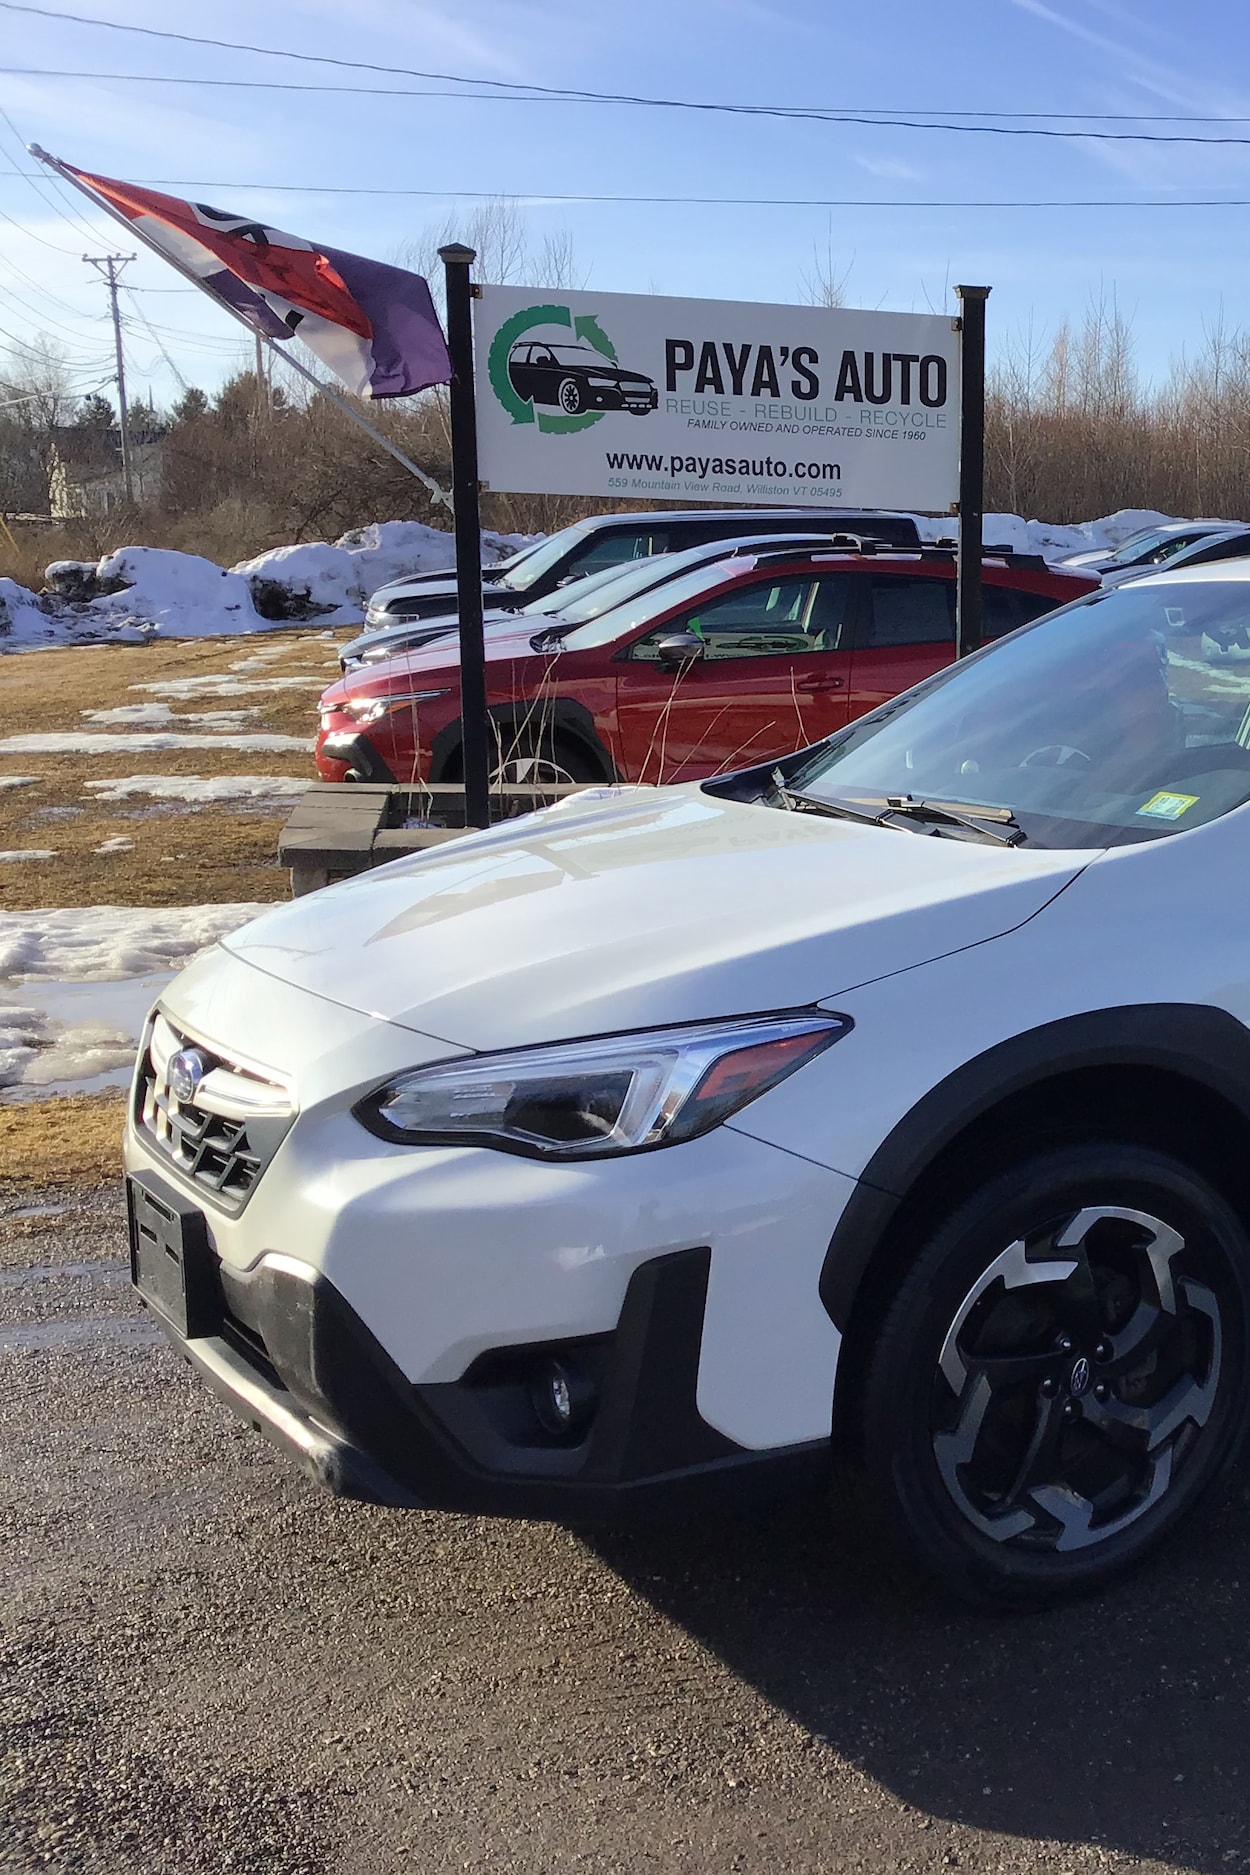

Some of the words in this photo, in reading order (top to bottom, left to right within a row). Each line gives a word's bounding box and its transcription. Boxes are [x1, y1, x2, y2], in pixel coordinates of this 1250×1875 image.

[665, 338, 819, 401] PAYA'S
[834, 350, 947, 408] AUTO
[666, 399, 732, 417] REUSE
[755, 403, 838, 423] REBUILD
[860, 409, 947, 429] RECYCLE
[687, 418, 727, 431] FAMILY
[729, 420, 774, 433] OWNED
[775, 423, 801, 435] AND
[802, 424, 863, 438] OPERATED
[865, 428, 899, 440] SINCE
[902, 430, 926, 441] 1960
[605, 452, 841, 480] www.payasauto.com
[608, 477, 629, 488] 559
[631, 478, 680, 491] Mountain
[684, 481, 709, 492] View
[747, 484, 790, 496] Williston
[793, 486, 808, 497] VT
[810, 487, 842, 498] 05495
